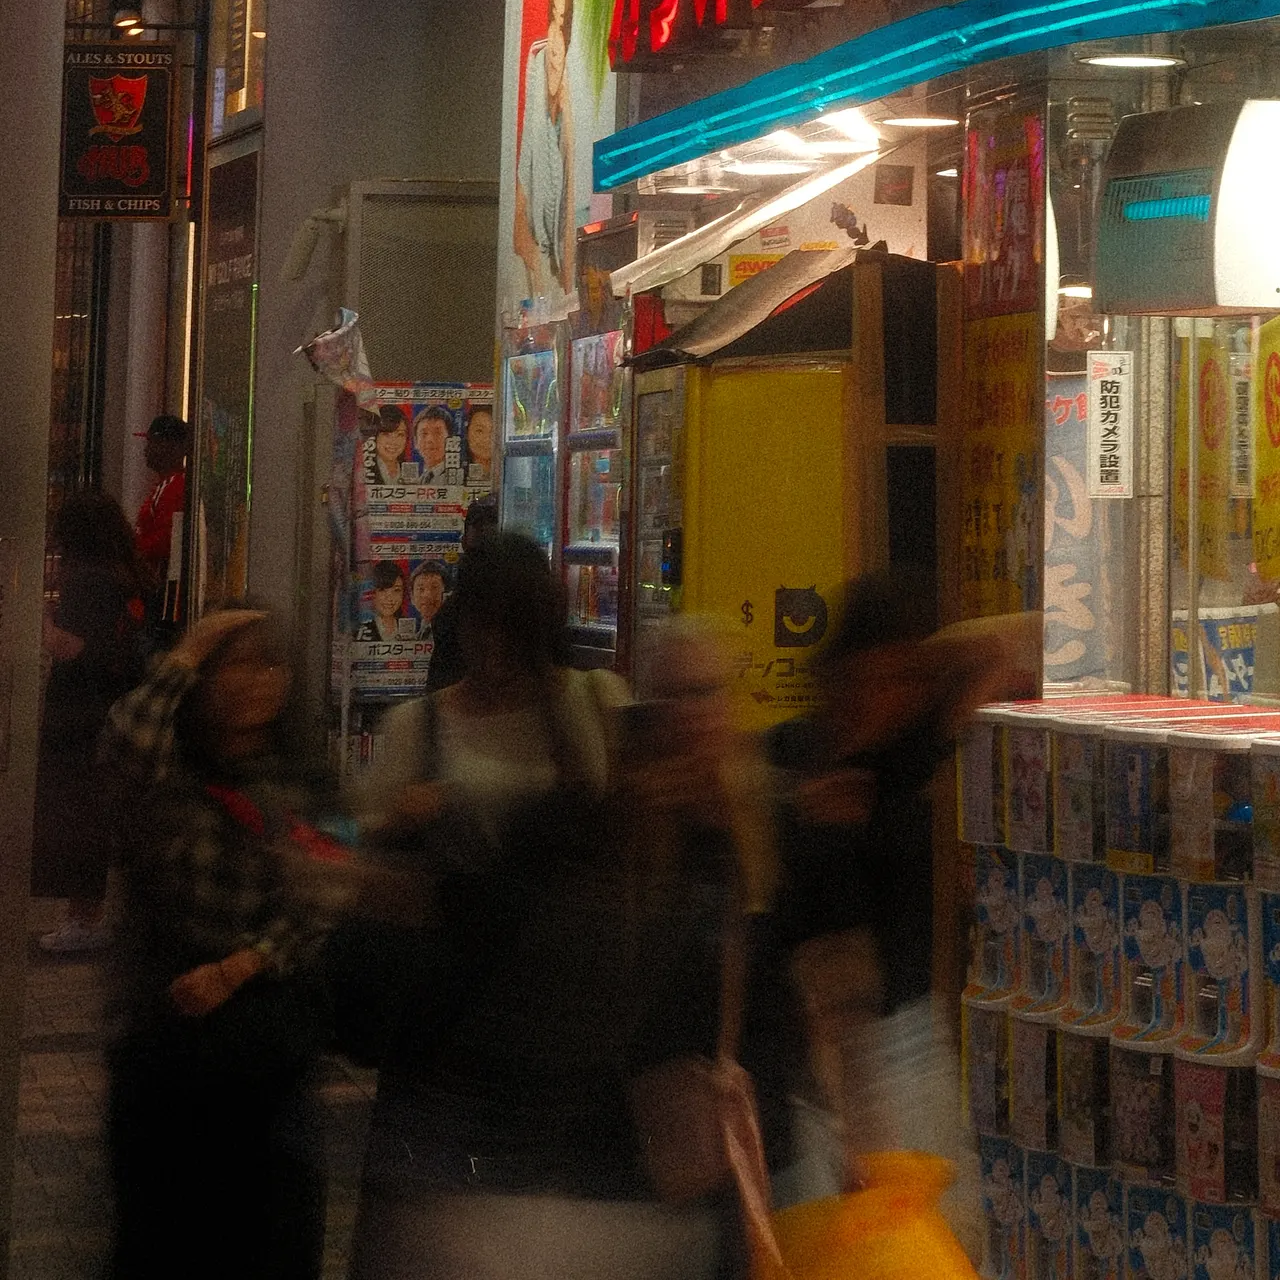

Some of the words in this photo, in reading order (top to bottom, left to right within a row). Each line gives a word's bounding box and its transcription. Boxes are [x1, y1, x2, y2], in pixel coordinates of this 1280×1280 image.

[66, 52, 102, 65] ALES
[103, 53, 114, 65] &
[117, 53, 173, 65] STOUTS
[68, 199, 101, 211] FISH
[104, 199, 115, 211] &
[117, 199, 161, 211] CHIPS
[1099, 379, 1122, 486] 防犯カメラ設置
